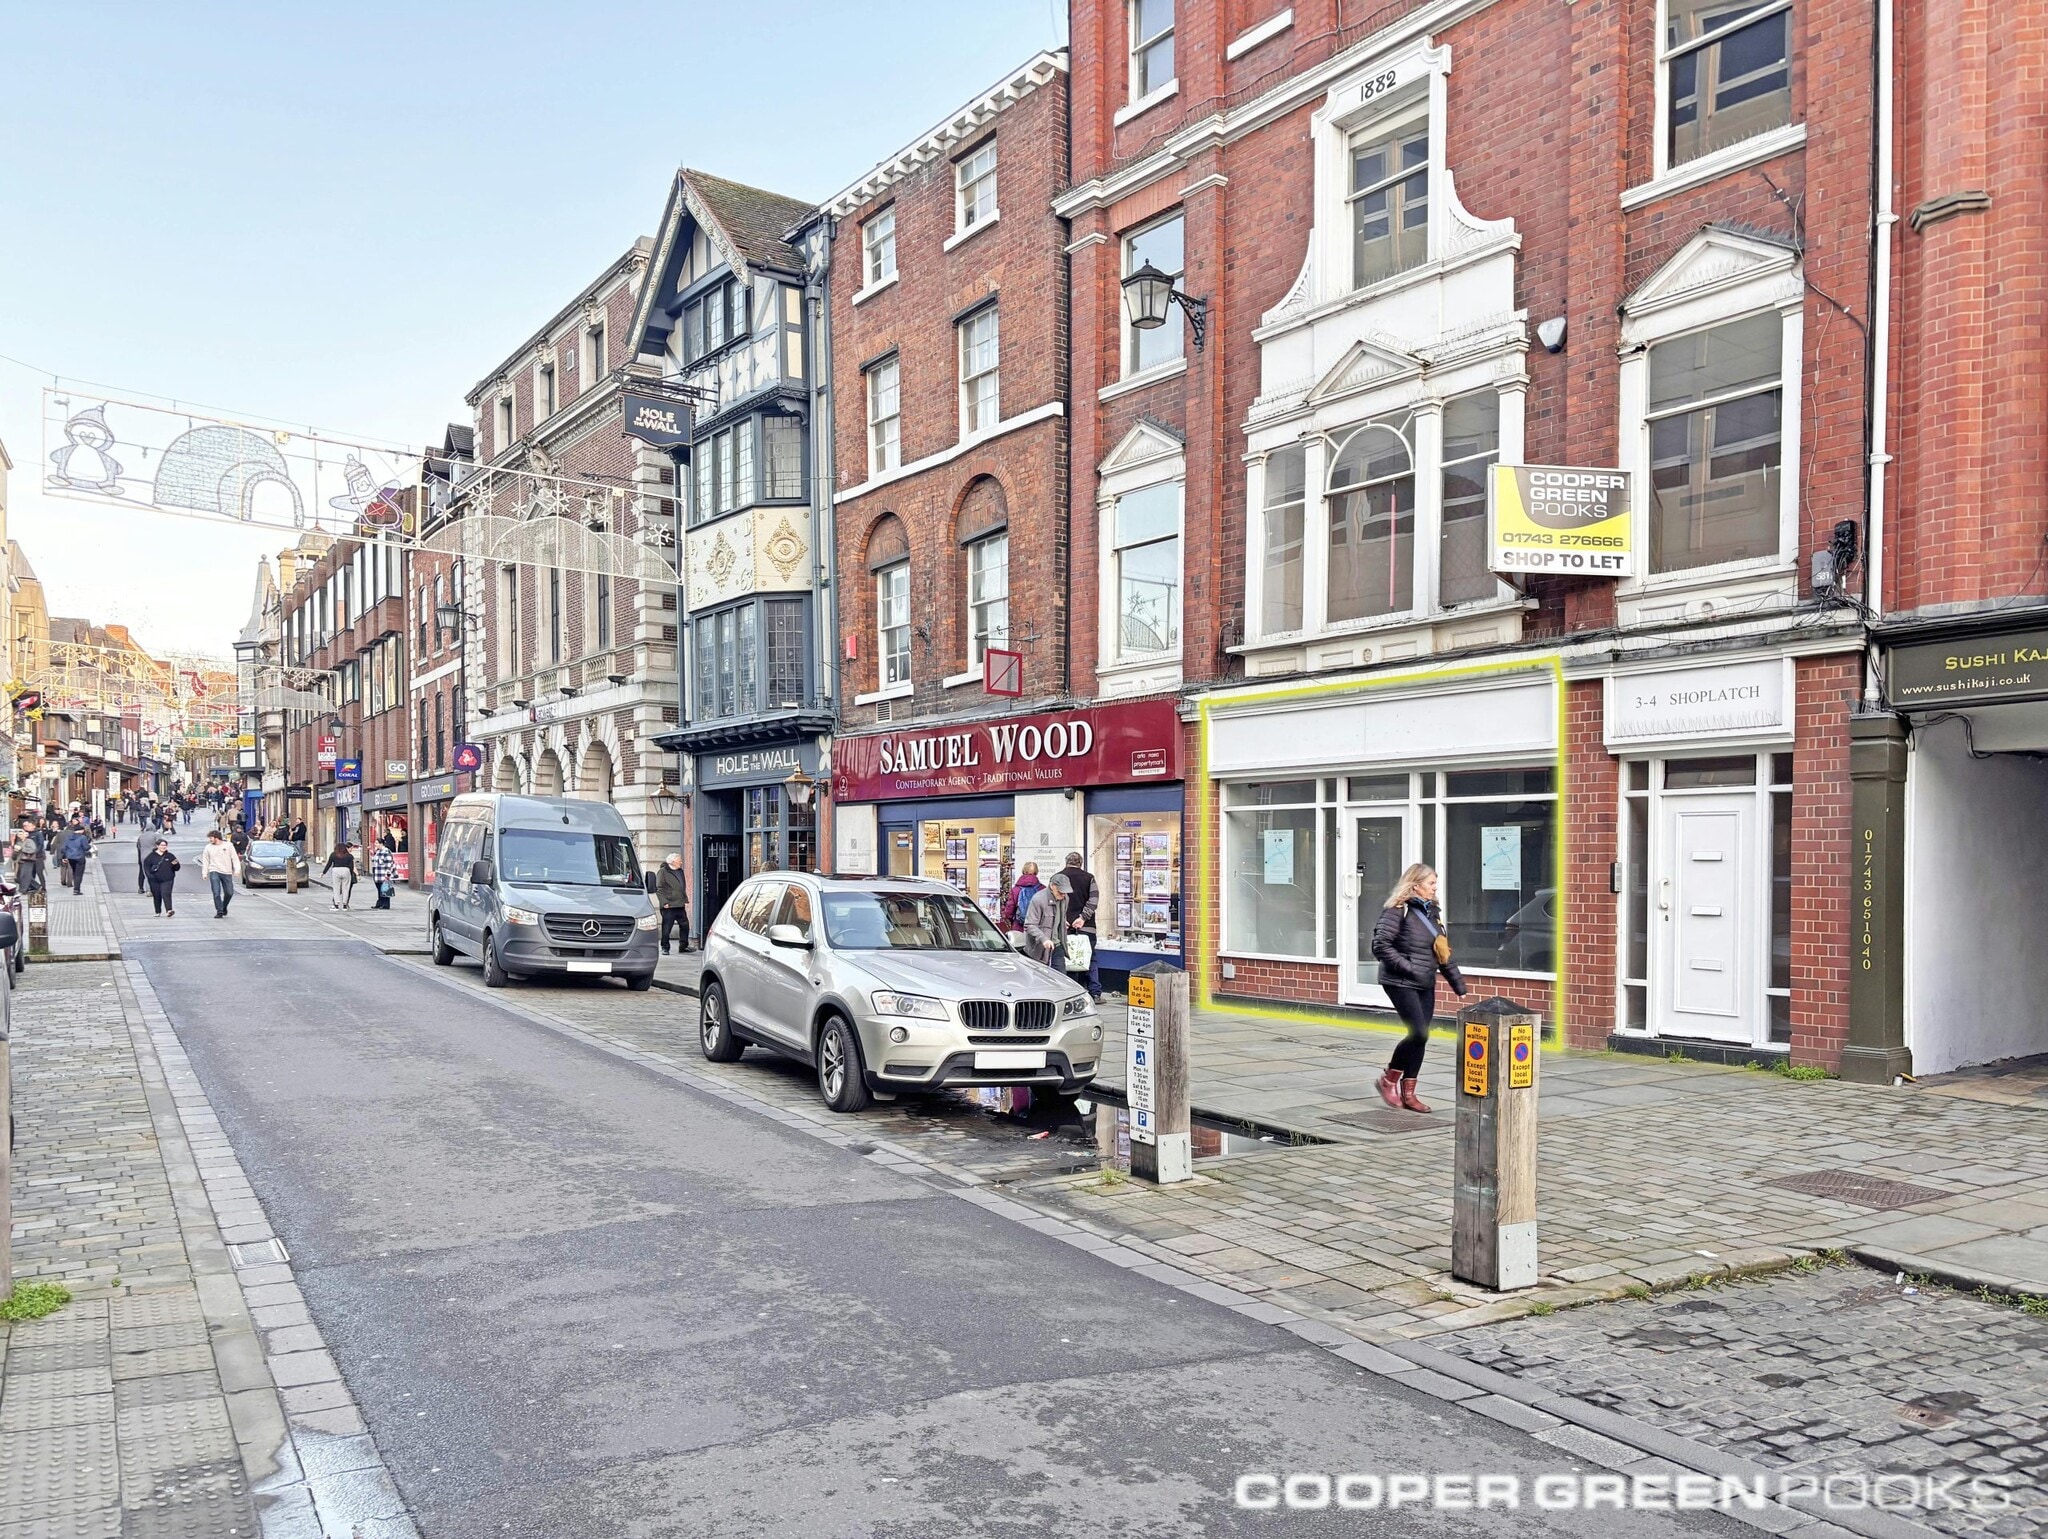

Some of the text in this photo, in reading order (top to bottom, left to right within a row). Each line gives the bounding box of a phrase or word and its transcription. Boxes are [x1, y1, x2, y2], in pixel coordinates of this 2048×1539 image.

[1361, 70, 1396, 101] 1882
[640, 407, 674, 422] HOLE
[644, 418, 681, 434] WALL
[1530, 472, 1624, 489] COOPER
[1530, 488, 1607, 502] GREEN
[1531, 502, 1607, 518] POOKS
[1503, 533, 1624, 547] 01743 276666
[1504, 552, 1624, 569] SHOP TO LET
[1945, 653, 2006, 670] SUSHI
[1902, 674, 2031, 695] www.sushikaji.co.uk
[1636, 685, 1760, 708] 3-4 SHOPLATCH
[880, 720, 1093, 774] SAMUEL WOOD
[388, 763, 406, 772] GO
[716, 755, 749, 774] HOLE
[752, 754, 758, 762] IN
[760, 748, 799, 769] WALL
[1134, 759, 1163, 768] propertymark
[895, 776, 946, 790] CONTEMPORARY
[947, 775, 976, 786] AGENCY
[983, 770, 1032, 783] TRADITIONAL
[1034, 768, 1062, 780] VALUES
[1864, 830, 1872, 891] 01743
[1862, 896, 1872, 970] 651040
[1467, 1033, 1487, 1041] waiting
[1466, 1061, 1486, 1070] Except
[1468, 1076, 1484, 1084] buses
